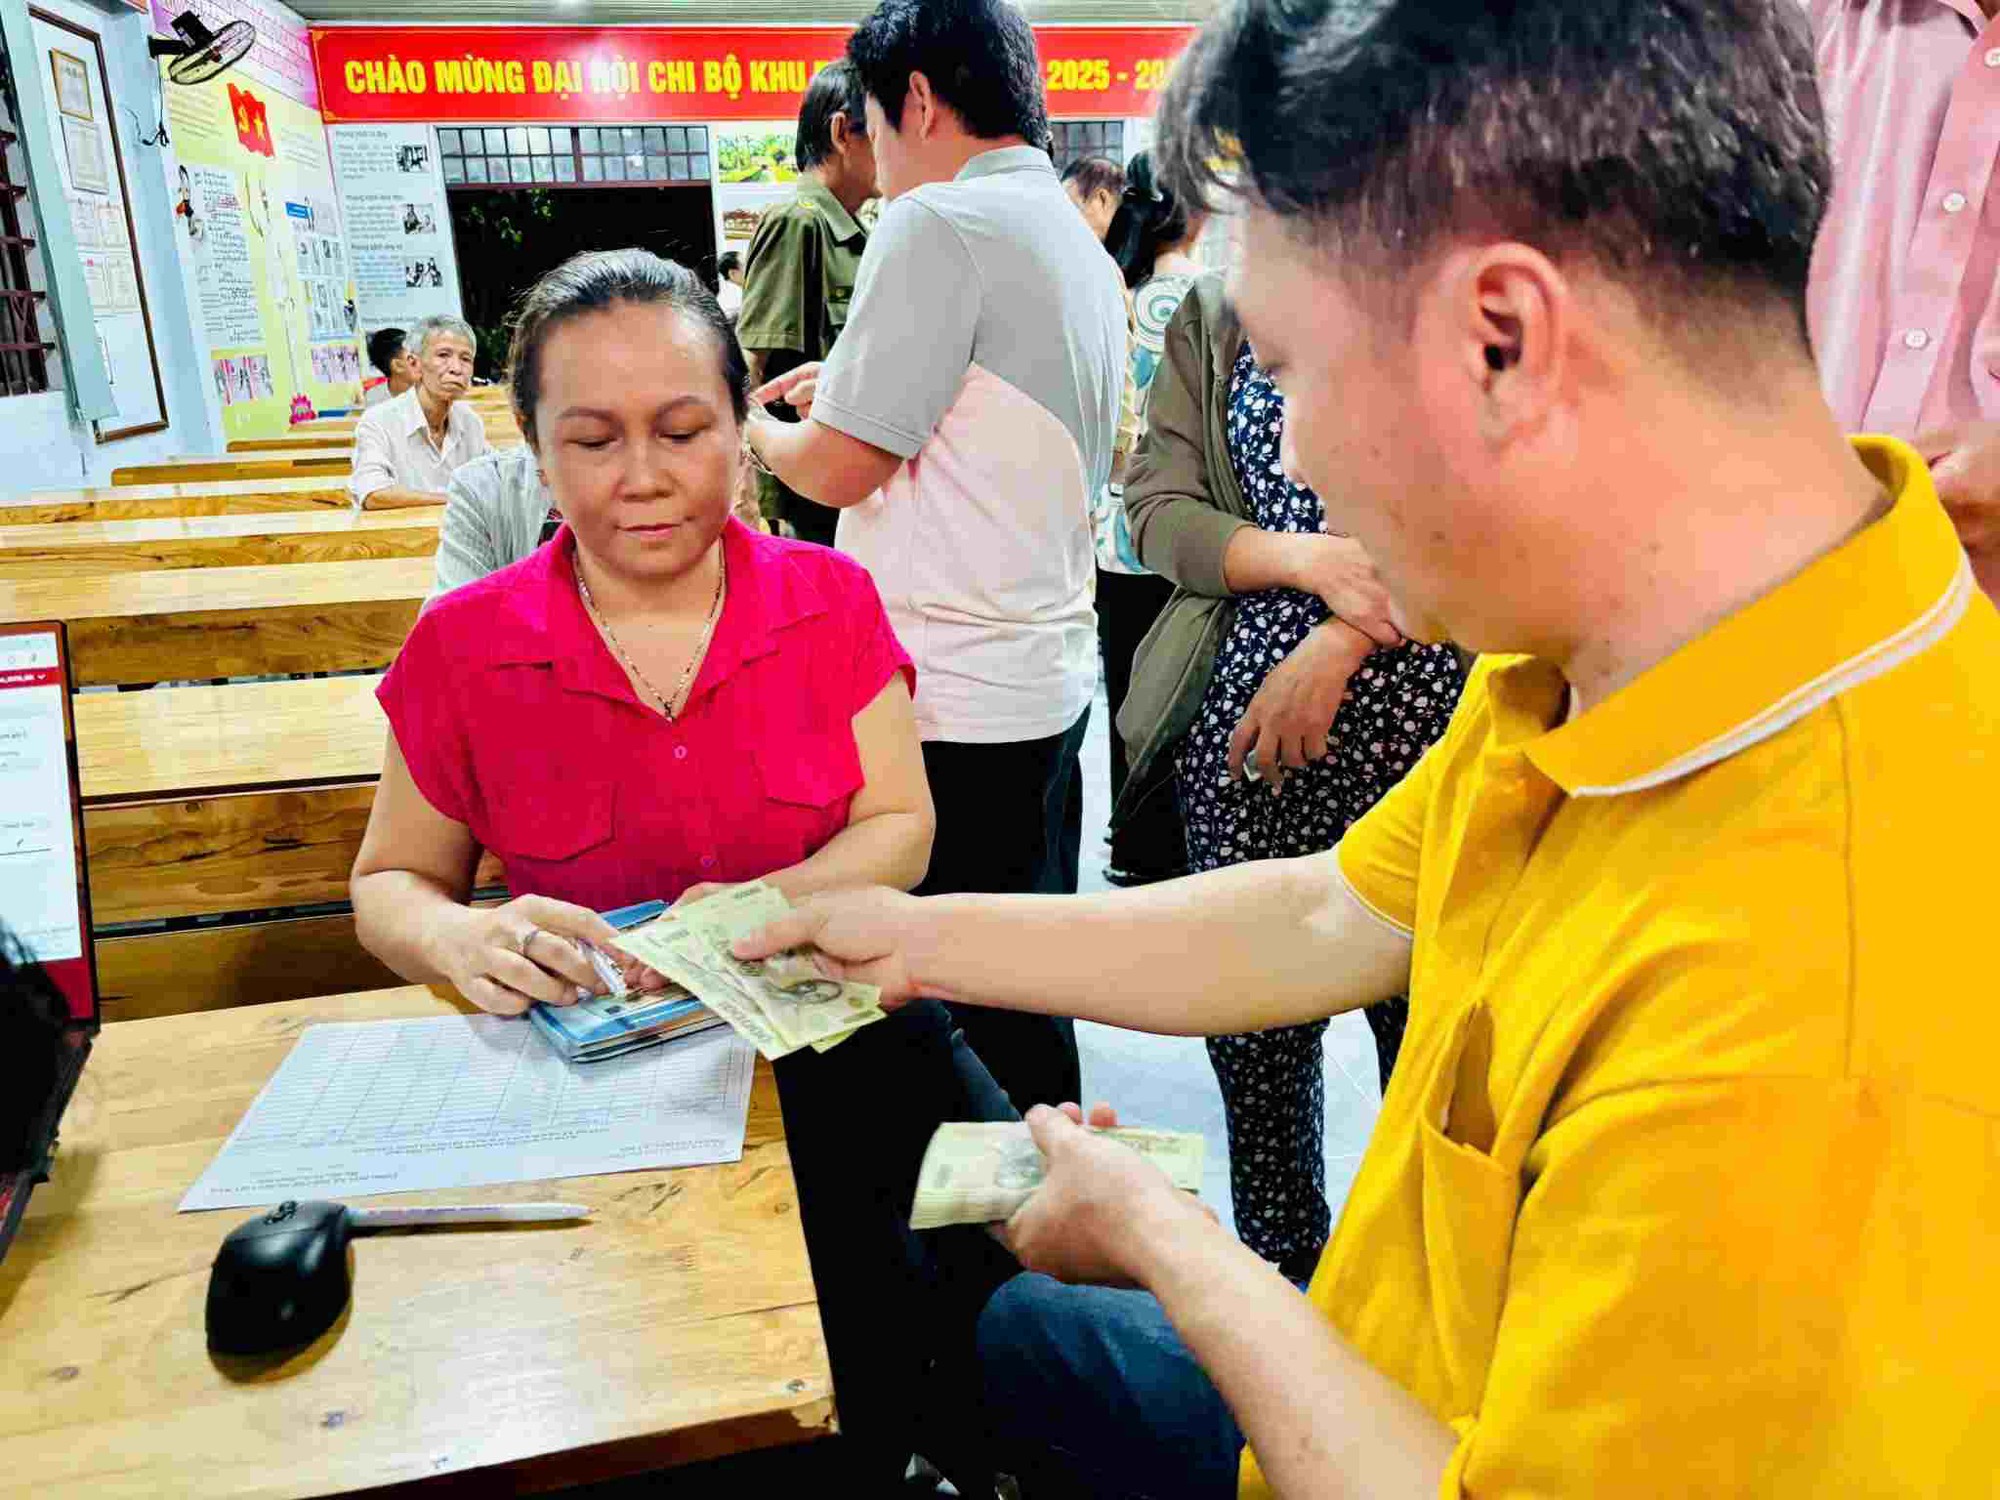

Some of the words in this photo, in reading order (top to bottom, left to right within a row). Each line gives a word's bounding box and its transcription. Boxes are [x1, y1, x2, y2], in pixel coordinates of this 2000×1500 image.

[344, 54, 427, 94] CHÀO
[434, 53, 526, 94] MỪNG
[533, 60, 582, 100] ĐẠI
[648, 61, 696, 94] CHI
[703, 53, 742, 100] BỘ
[750, 60, 806, 93] KHU
[1046, 59, 1110, 91] 2025
[1134, 58, 1175, 92] 20
